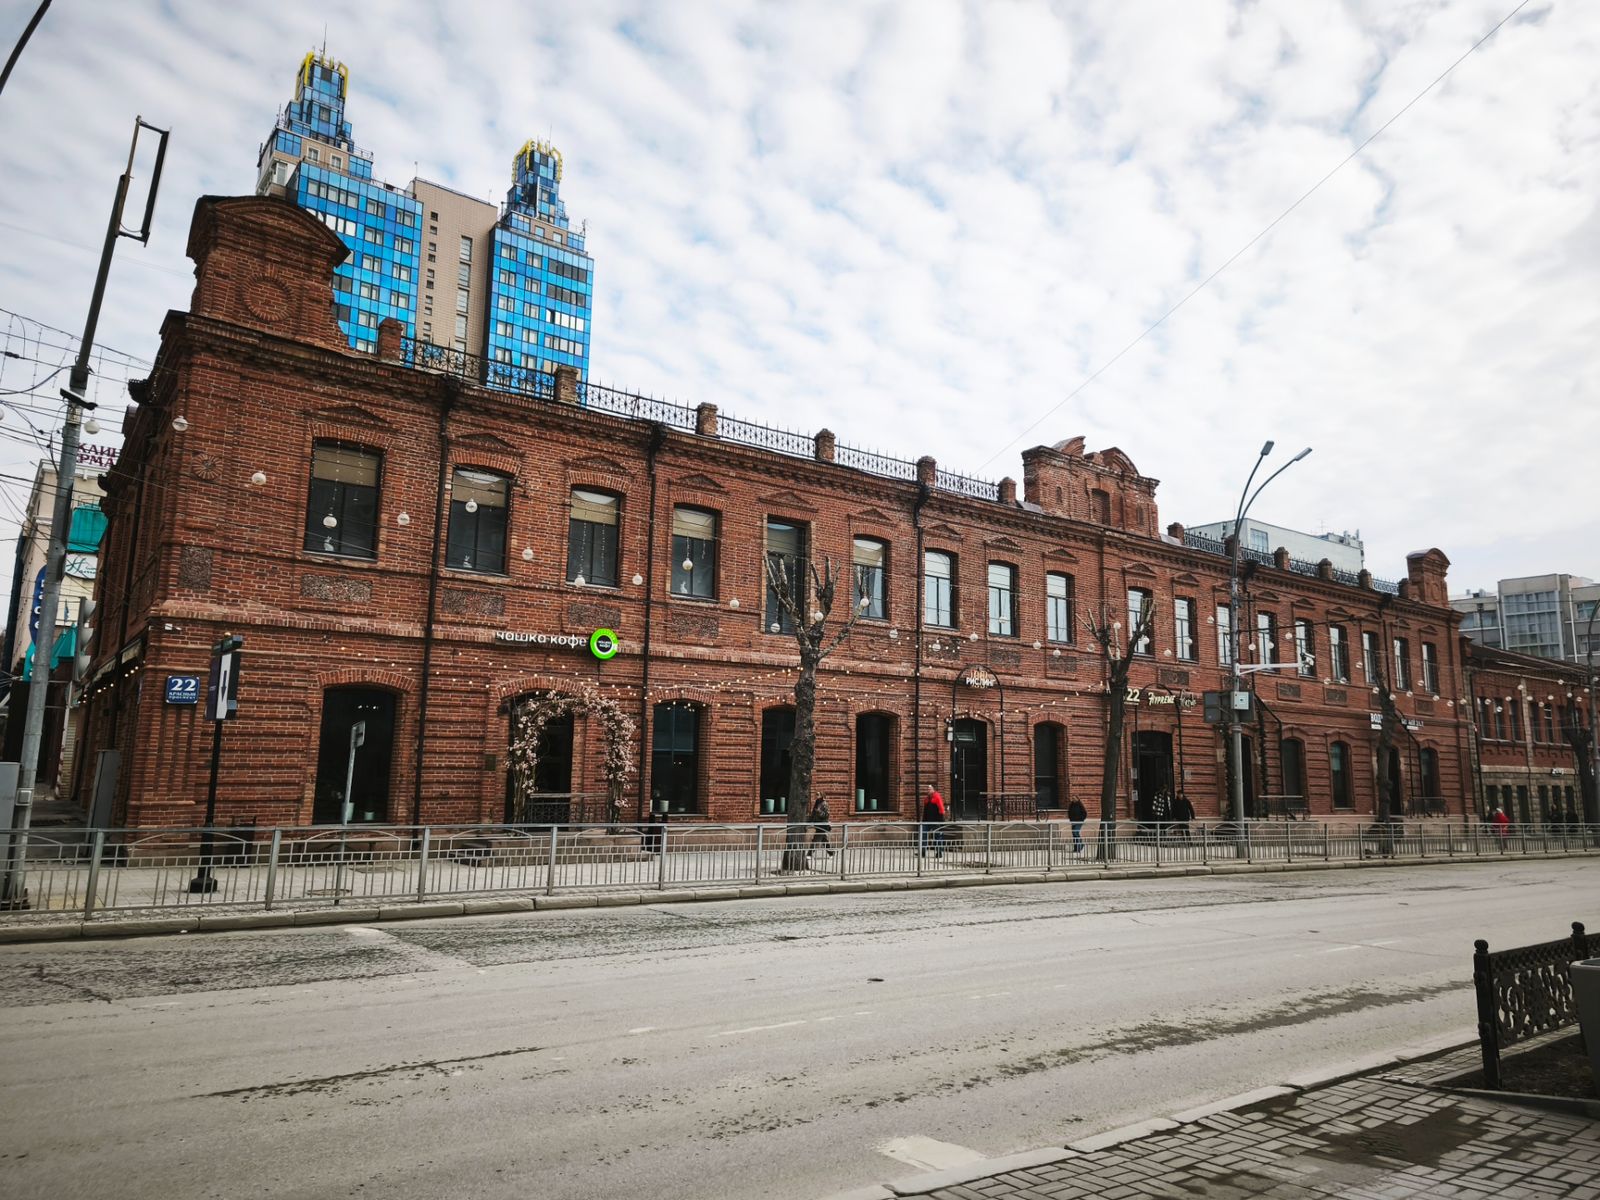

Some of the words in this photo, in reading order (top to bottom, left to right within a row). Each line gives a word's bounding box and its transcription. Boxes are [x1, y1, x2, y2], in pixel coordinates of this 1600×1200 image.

[496, 631, 547, 644] чашка
[550, 634, 587, 648] кофе
[171, 679, 196, 691] 22
[1126, 688, 1140, 702] 22
